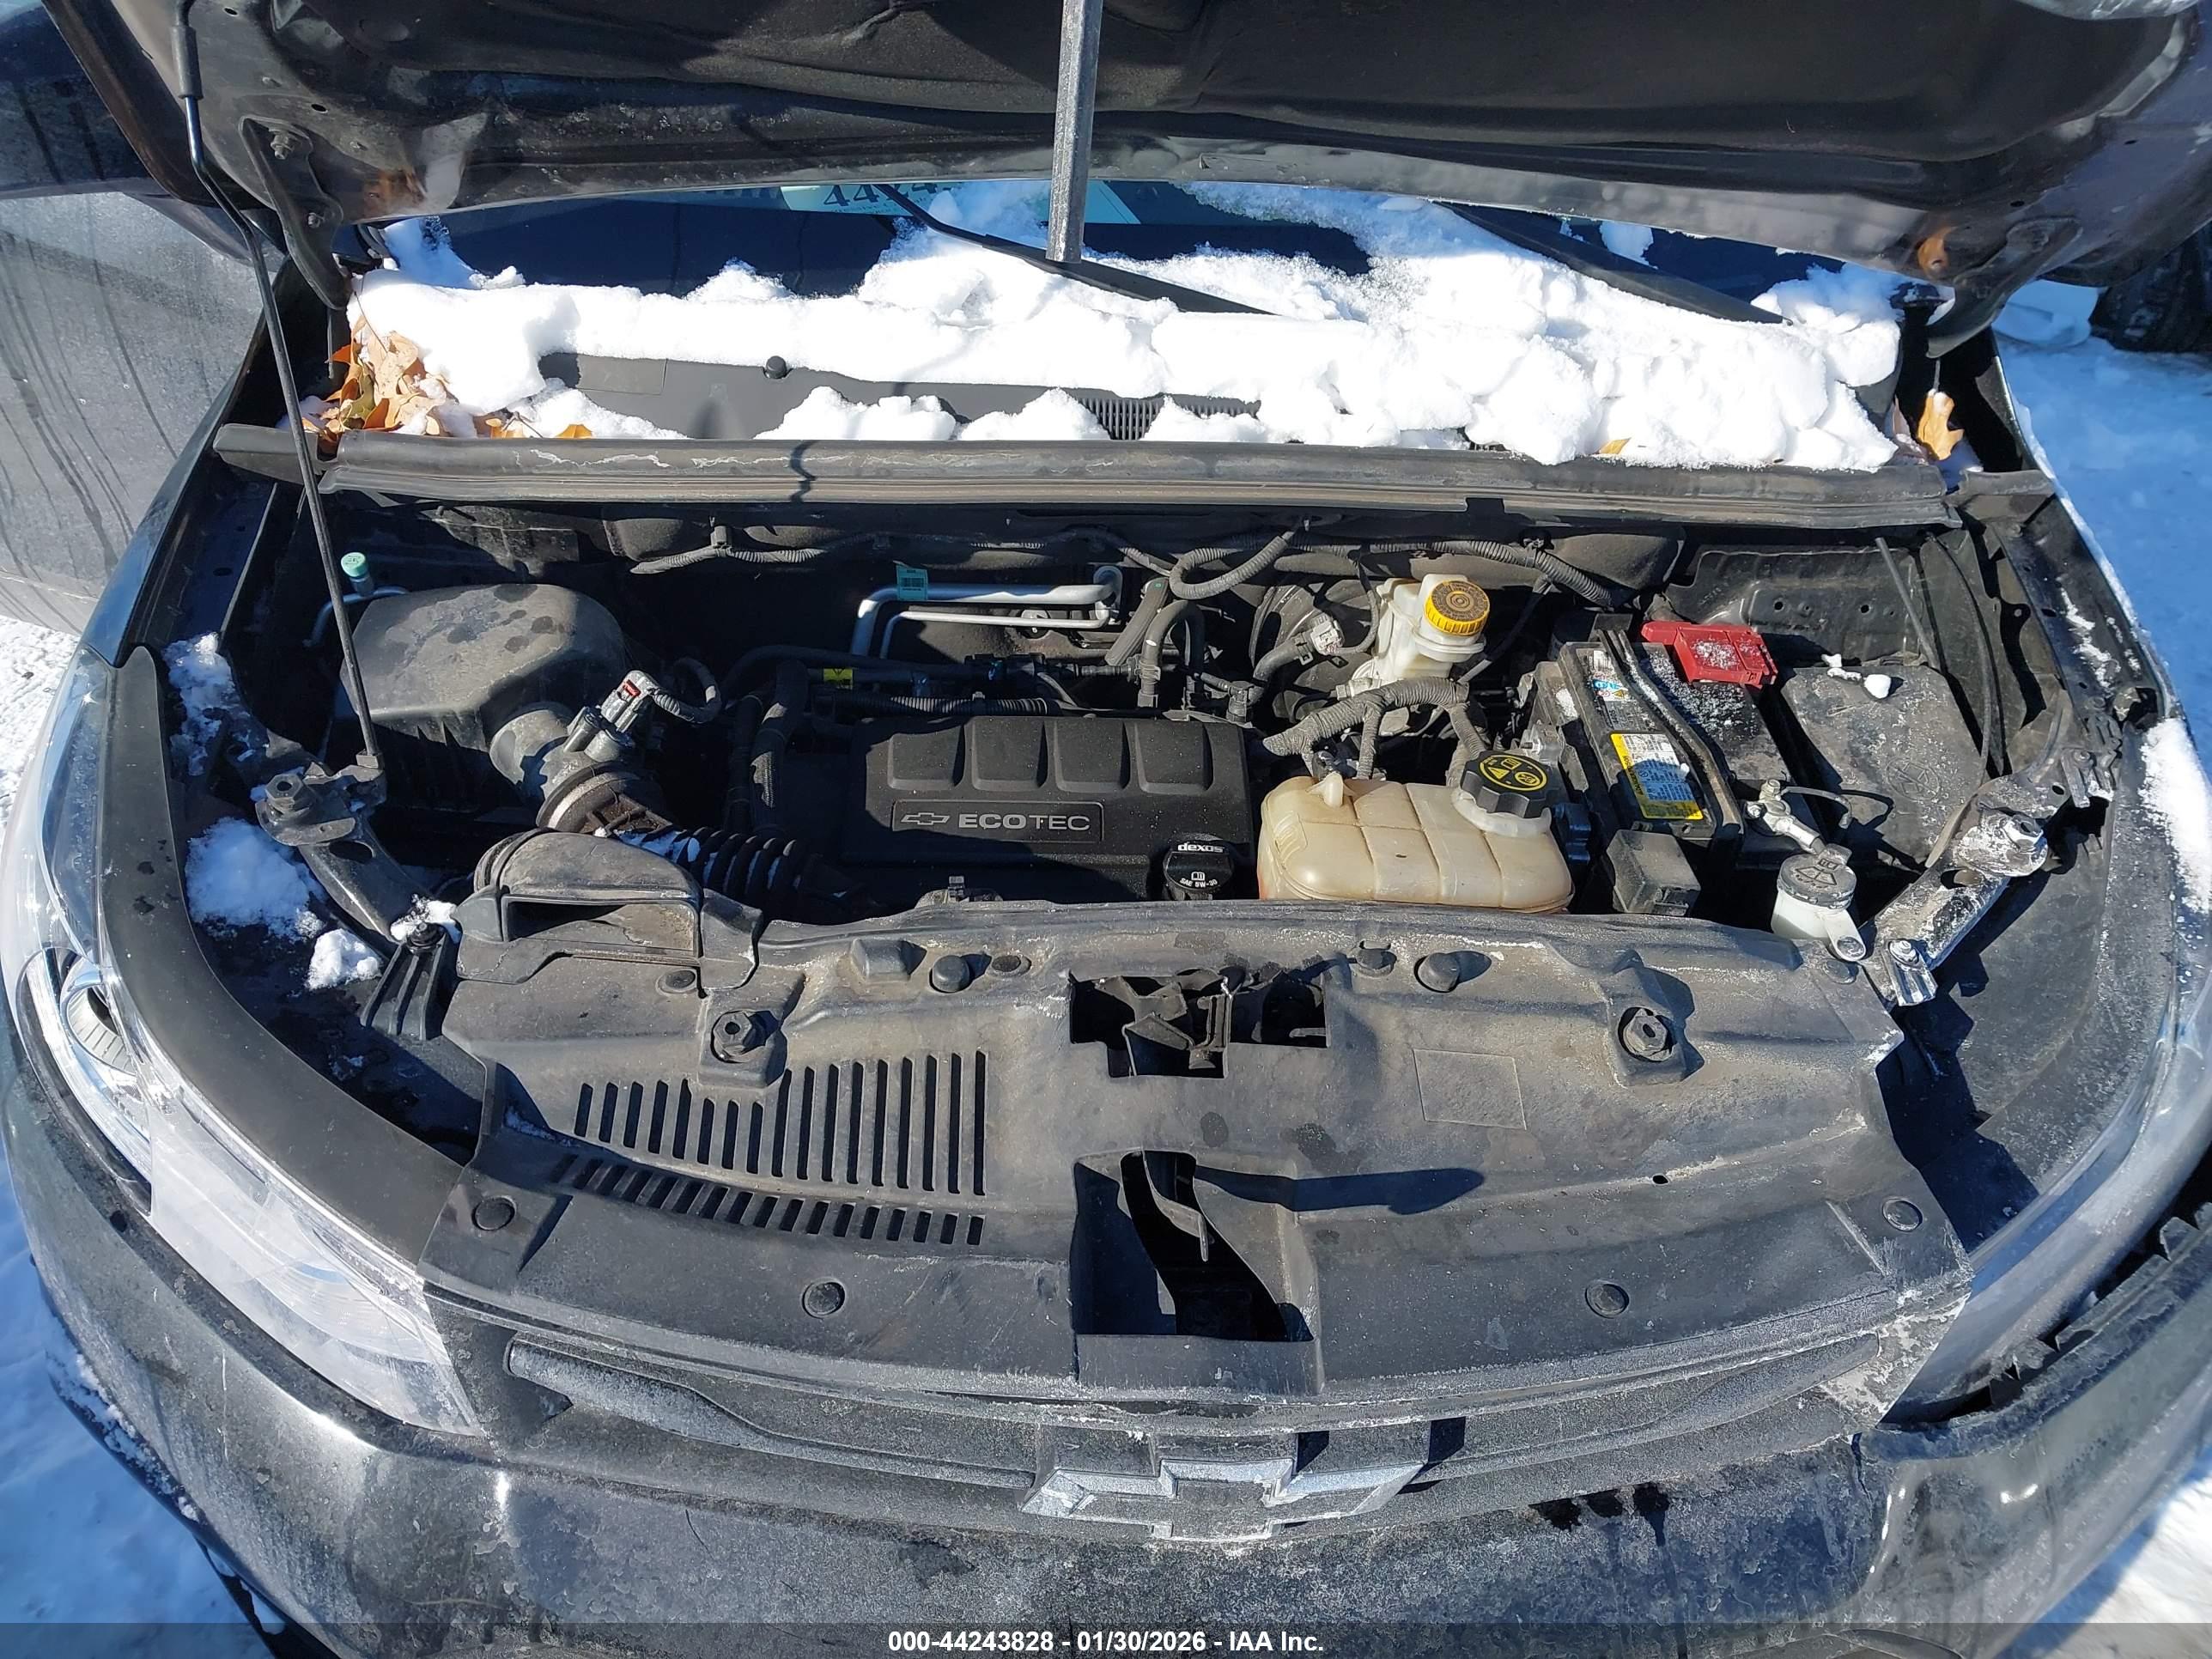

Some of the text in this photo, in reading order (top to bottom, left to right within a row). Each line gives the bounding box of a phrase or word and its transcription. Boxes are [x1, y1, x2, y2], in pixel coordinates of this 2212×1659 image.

[958, 813, 1091, 830] ECOTEC
[1177, 842, 1224, 853] dexos
[1179, 878, 1218, 888] SAE 5W-30
